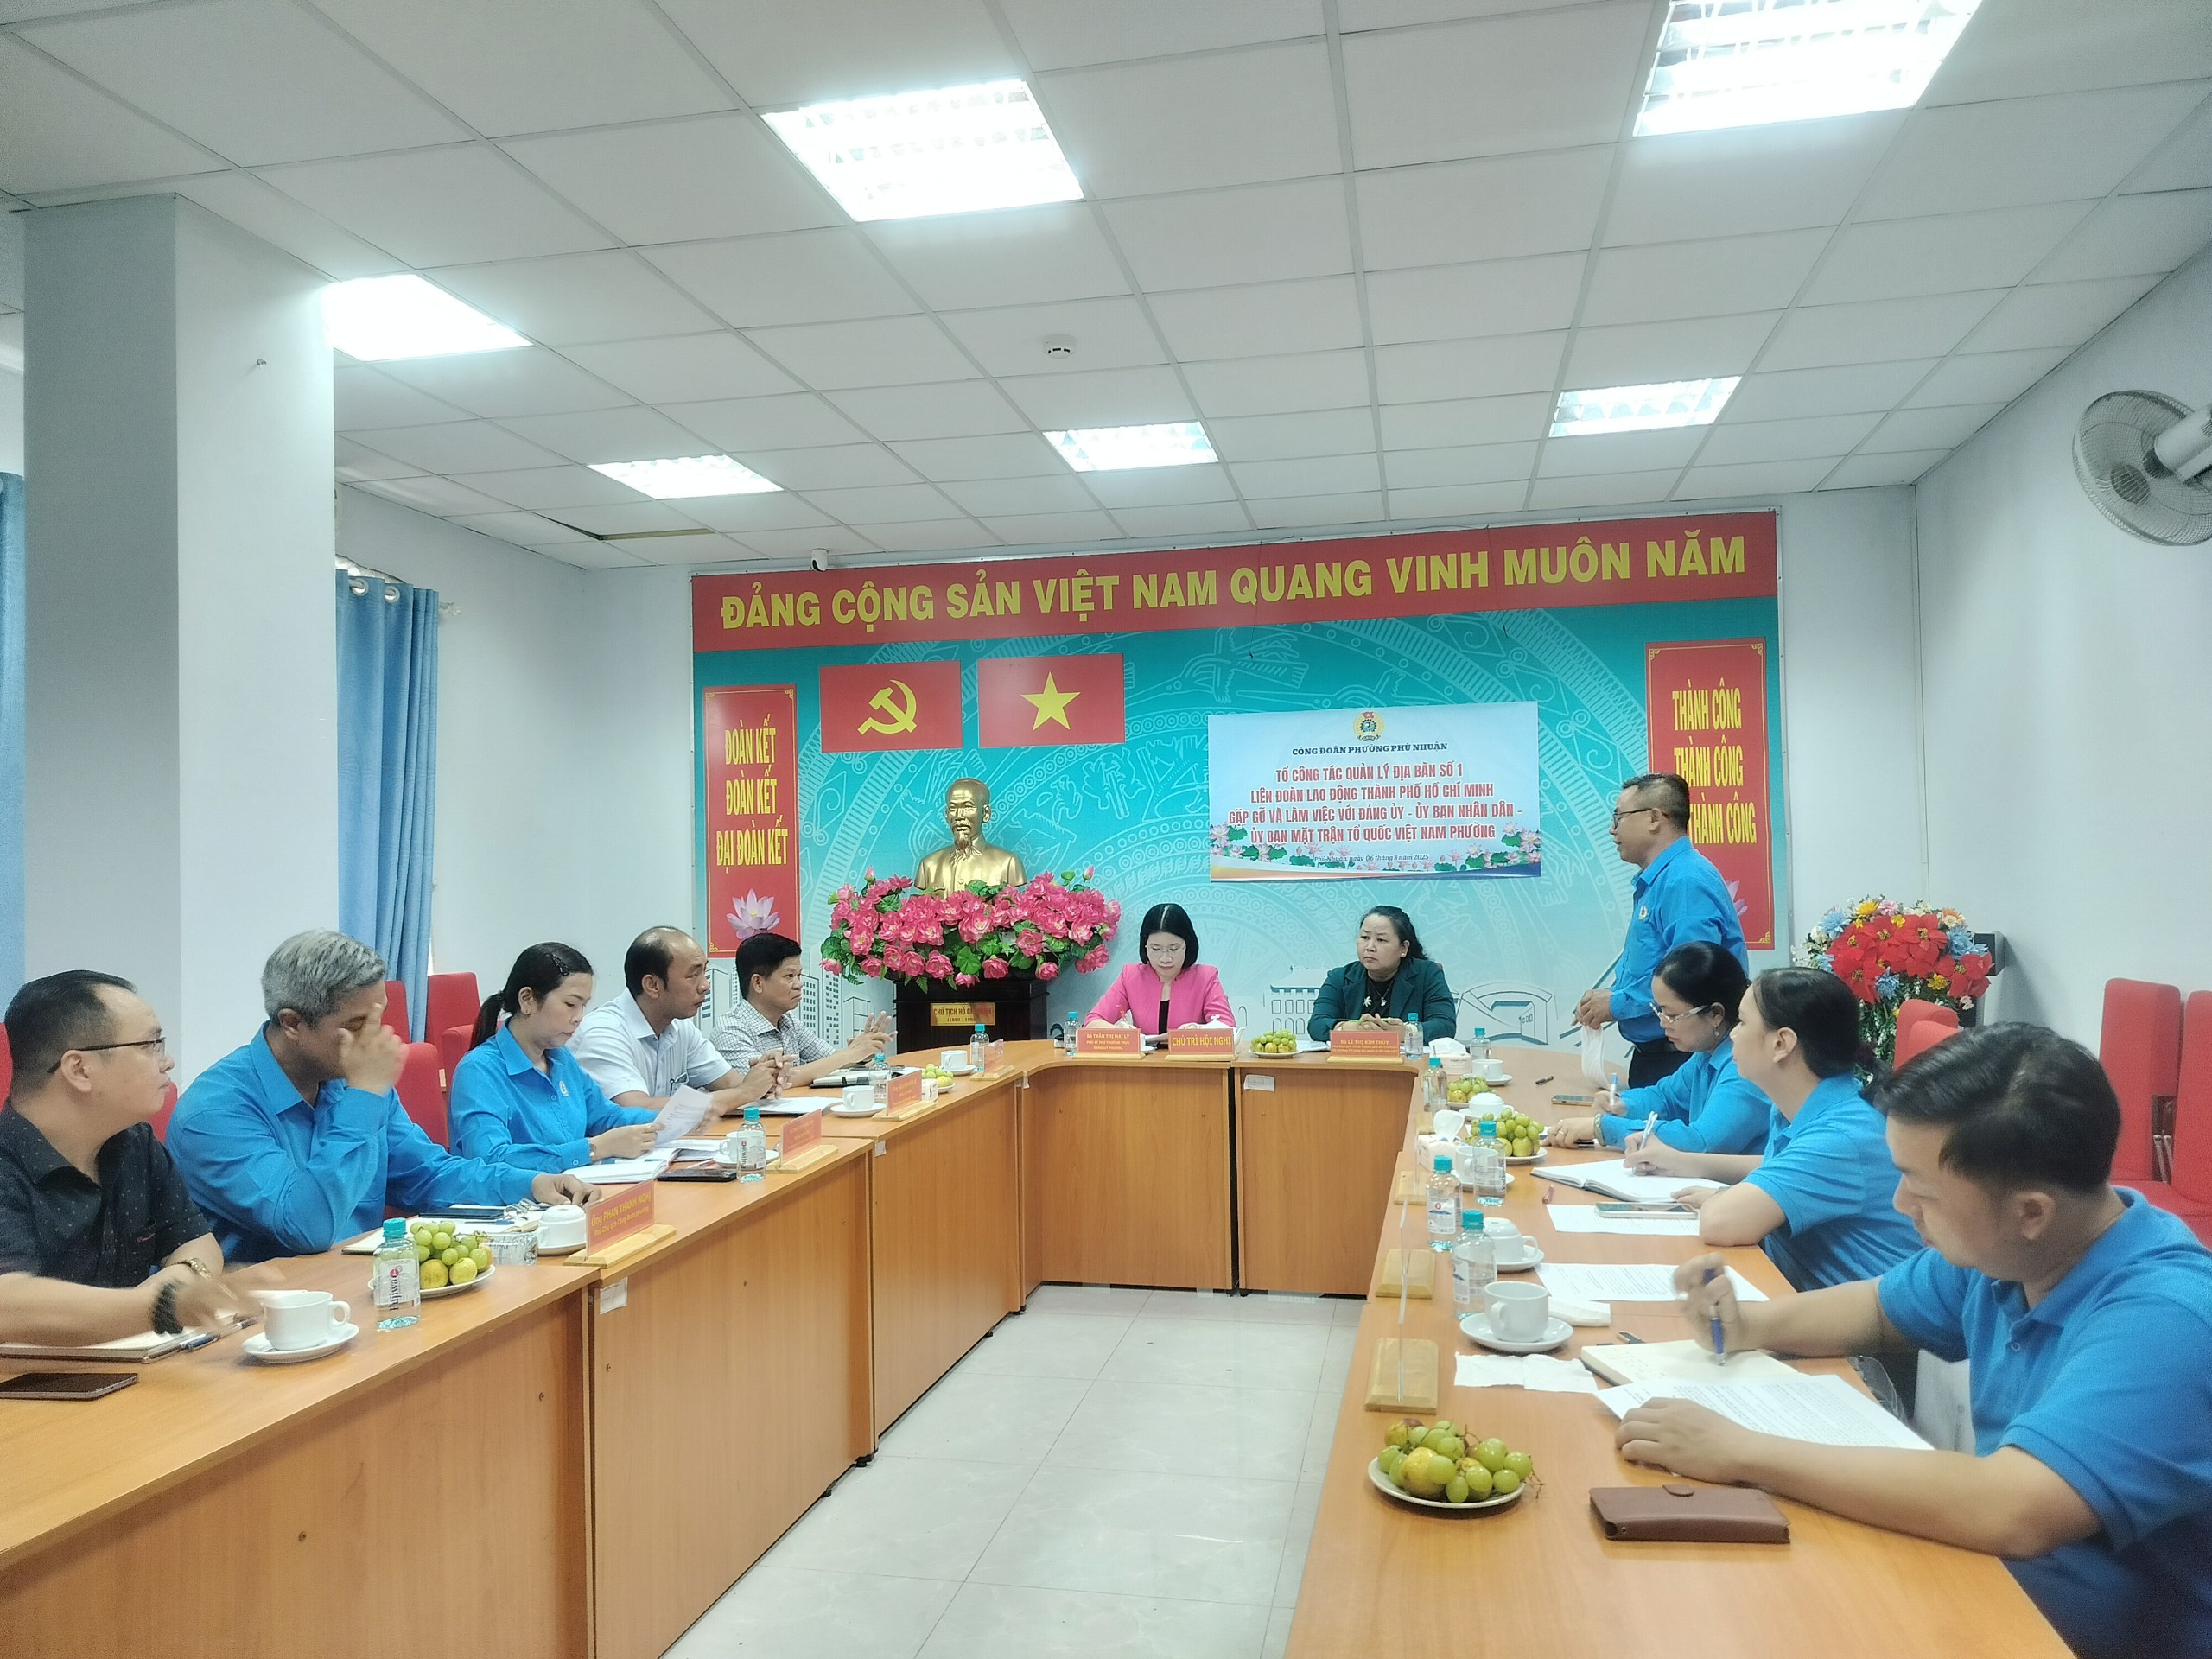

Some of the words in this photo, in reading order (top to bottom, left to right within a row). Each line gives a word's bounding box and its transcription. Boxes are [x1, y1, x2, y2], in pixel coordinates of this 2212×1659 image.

[721, 582, 821, 629] ĐẢNG
[832, 581, 935, 632] CỘNG
[946, 569, 1020, 619] SẢN
[1033, 569, 1120, 621] VIỆT
[1133, 569, 1217, 608] NAM
[1230, 559, 1373, 606] QUANG
[1386, 550, 1490, 594] VINH
[1503, 537, 1631, 587] MUÔN
[1646, 529, 1745, 577] NĂM
[1672, 678, 1710, 731] THÀNH
[1712, 677, 1743, 731] CÔNG
[725, 718, 754, 766] ĐOÀN
[756, 713, 777, 764] KẾT
[1292, 746, 1319, 755] CÔNG
[1319, 745, 1347, 754] ĐOÀN
[1348, 744, 1389, 753] PHƯỜNG
[1390, 743, 1411, 752] PHÚ
[1413, 742, 1448, 752] NHUẬN
[1275, 766, 1289, 782] TỔ
[1292, 765, 1320, 782] CÔNG
[1323, 765, 1343, 781] TÁC
[1345, 762, 1374, 781] QUẢN
[1377, 763, 1390, 779] LÝ
[1393, 765, 1411, 781] ĐỊA
[1414, 761, 1436, 778] BÀN
[1440, 760, 1455, 777] SỐ
[1456, 763, 1462, 776] 1
[1674, 735, 1712, 787] THÀNH
[1713, 734, 1744, 787] CÔNG
[726, 769, 755, 816] ĐOÀN
[757, 764, 778, 815] KẾT
[1250, 787, 1273, 804] LIÊN
[1275, 786, 1304, 803] ĐOÀN
[1306, 788, 1326, 802] LAO
[1329, 785, 1358, 804] ĐỘNG
[1361, 784, 1396, 799] THÀNH
[1399, 782, 1422, 799] PHỐ
[1442, 781, 1461, 798] CHÍ
[1464, 783, 1494, 797] MINH
[1229, 808, 1249, 827] GẶP
[1253, 807, 1266, 823] GỠ
[1268, 808, 1283, 823] VÀ
[1286, 808, 1309, 823] LÀM
[1313, 805, 1335, 824] VIỆC
[1338, 804, 1356, 821] VỚI
[1358, 803, 1387, 820] ĐẢNG
[1390, 802, 1404, 819] ỦY
[1415, 801, 1429, 819] ỦY
[1433, 804, 1455, 818] BAN
[1458, 801, 1488, 817] NHÂN
[1491, 800, 1514, 817] DÂN
[1726, 791, 1757, 844] CÔNG
[716, 830, 734, 874] ĐẠI
[736, 819, 766, 866] ĐOÀN
[767, 814, 789, 866] KẾT
[1250, 825, 1264, 843] ỦY
[1267, 830, 1287, 843] BAN
[1291, 827, 1314, 844] MẶT
[1317, 826, 1344, 844] TRẬN
[1347, 824, 1361, 841] TỔ
[1363, 823, 1392, 842] QUỐC
[1395, 823, 1418, 842] VIỆT
[1421, 826, 1446, 840] NAM
[1450, 822, 1496, 838] PHƯỜNG
[1172, 1034, 1185, 1046] CHỦ
[1186, 1034, 1198, 1046] TRÌ
[1200, 1034, 1213, 1048] HỘI
[1214, 1036, 1231, 1047] NGHỊ
[591, 1214, 602, 1227] Ông
[389, 1279, 402, 1311] Fujiwa
